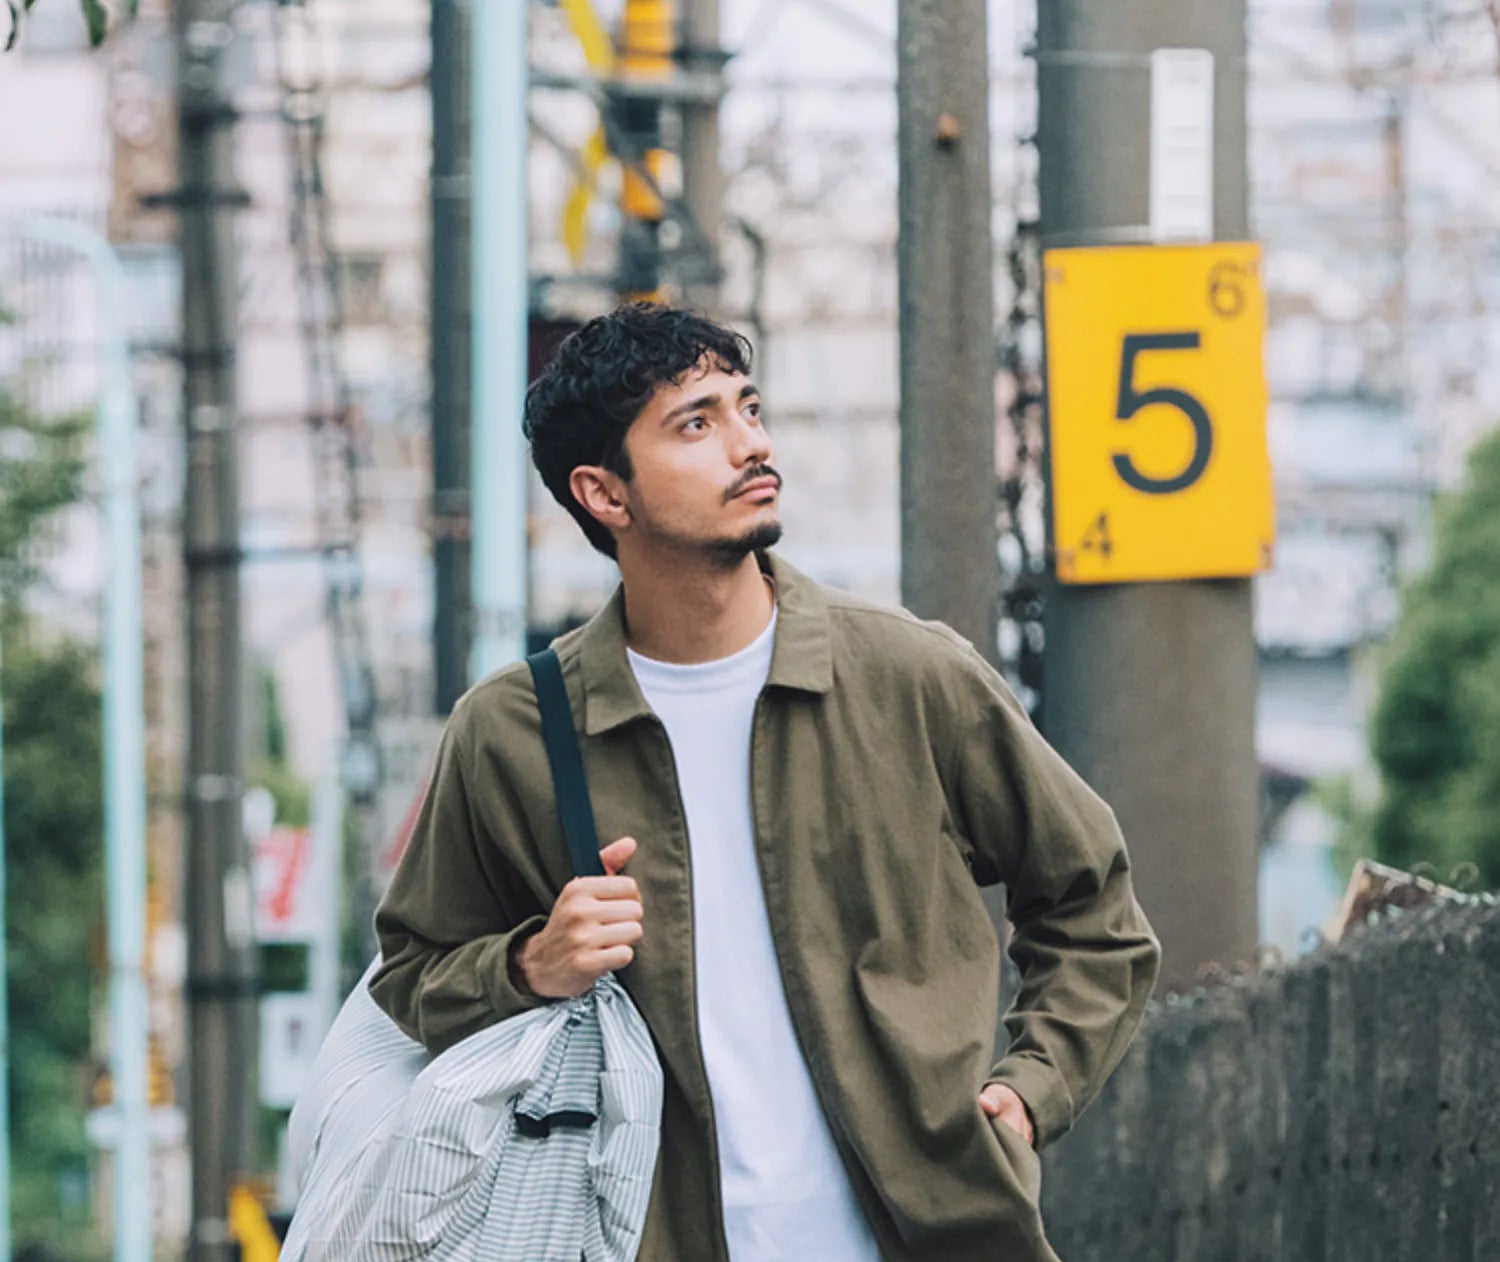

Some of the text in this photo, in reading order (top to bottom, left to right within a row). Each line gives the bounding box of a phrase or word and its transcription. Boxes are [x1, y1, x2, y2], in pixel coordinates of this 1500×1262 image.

[1208, 260, 1245, 319] 6
[1112, 332, 1213, 494] 5
[1082, 511, 1112, 560] 4
